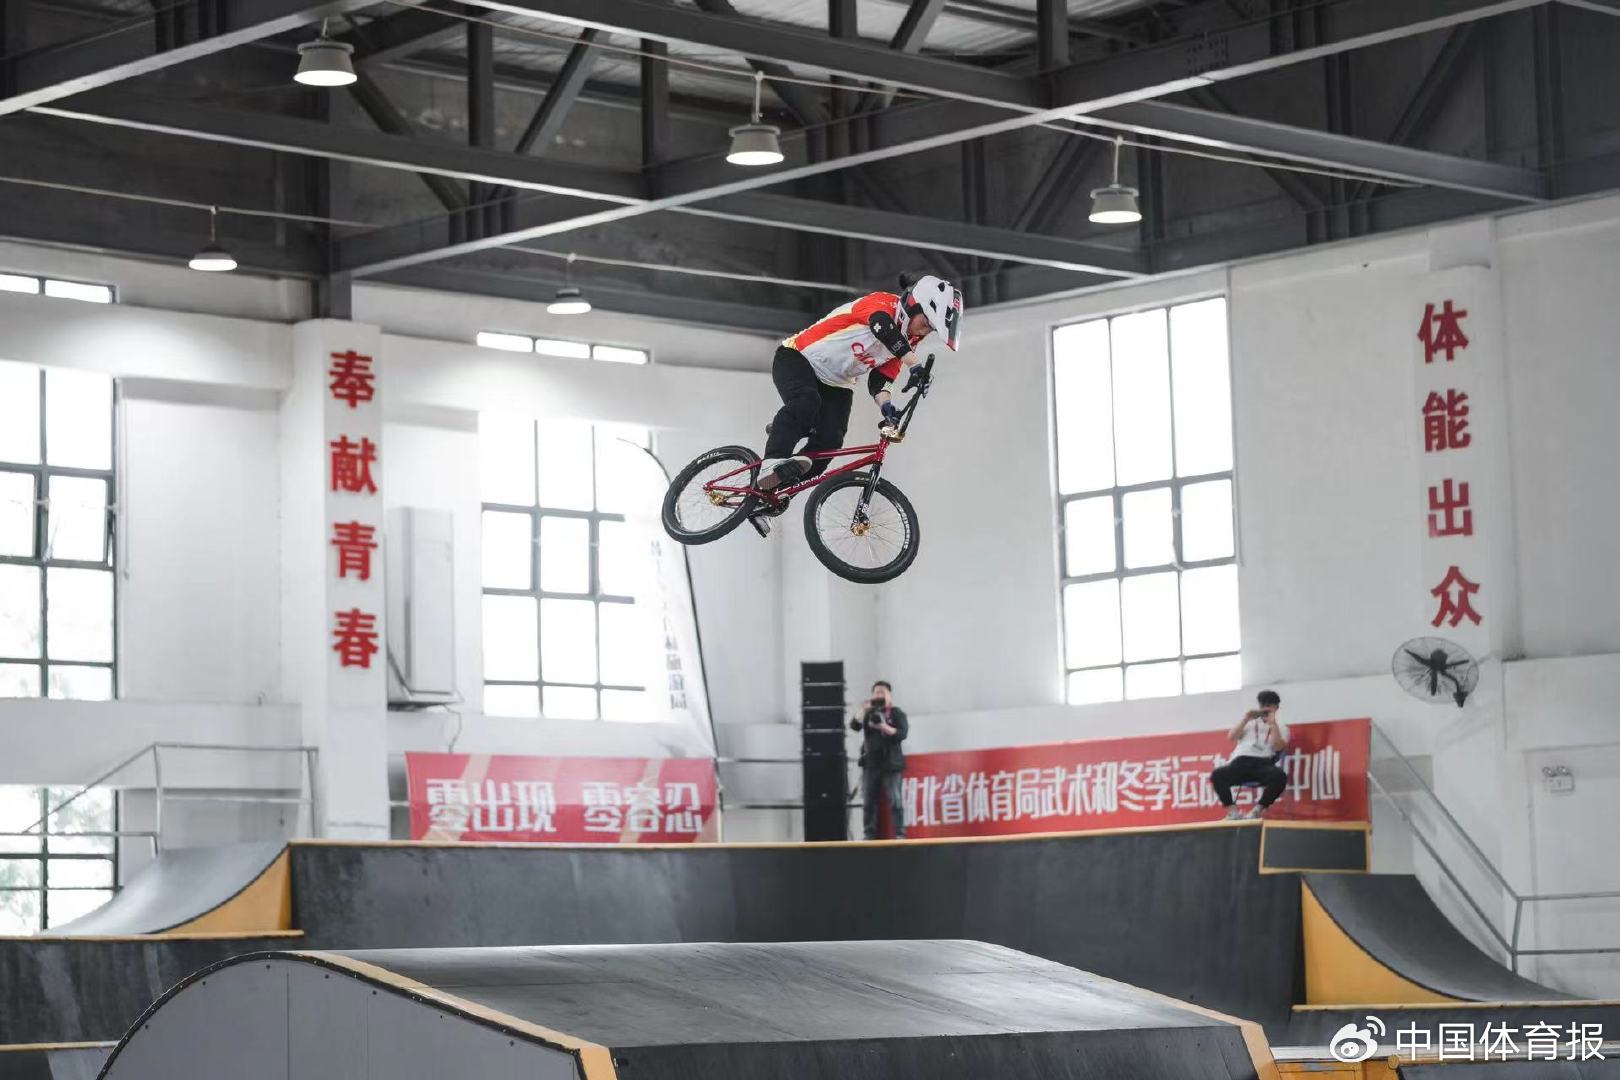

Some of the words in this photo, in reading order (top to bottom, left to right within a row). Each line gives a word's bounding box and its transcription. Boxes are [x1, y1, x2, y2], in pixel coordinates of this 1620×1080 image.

[329, 349, 379, 669] 奉献青春
[1417, 299, 1482, 628] 体能出众
[426, 778, 557, 833] 零出现
[582, 780, 703, 833] 零容忍
[902, 745, 1341, 827] 湖北省体育局武术和冬季运动中心
